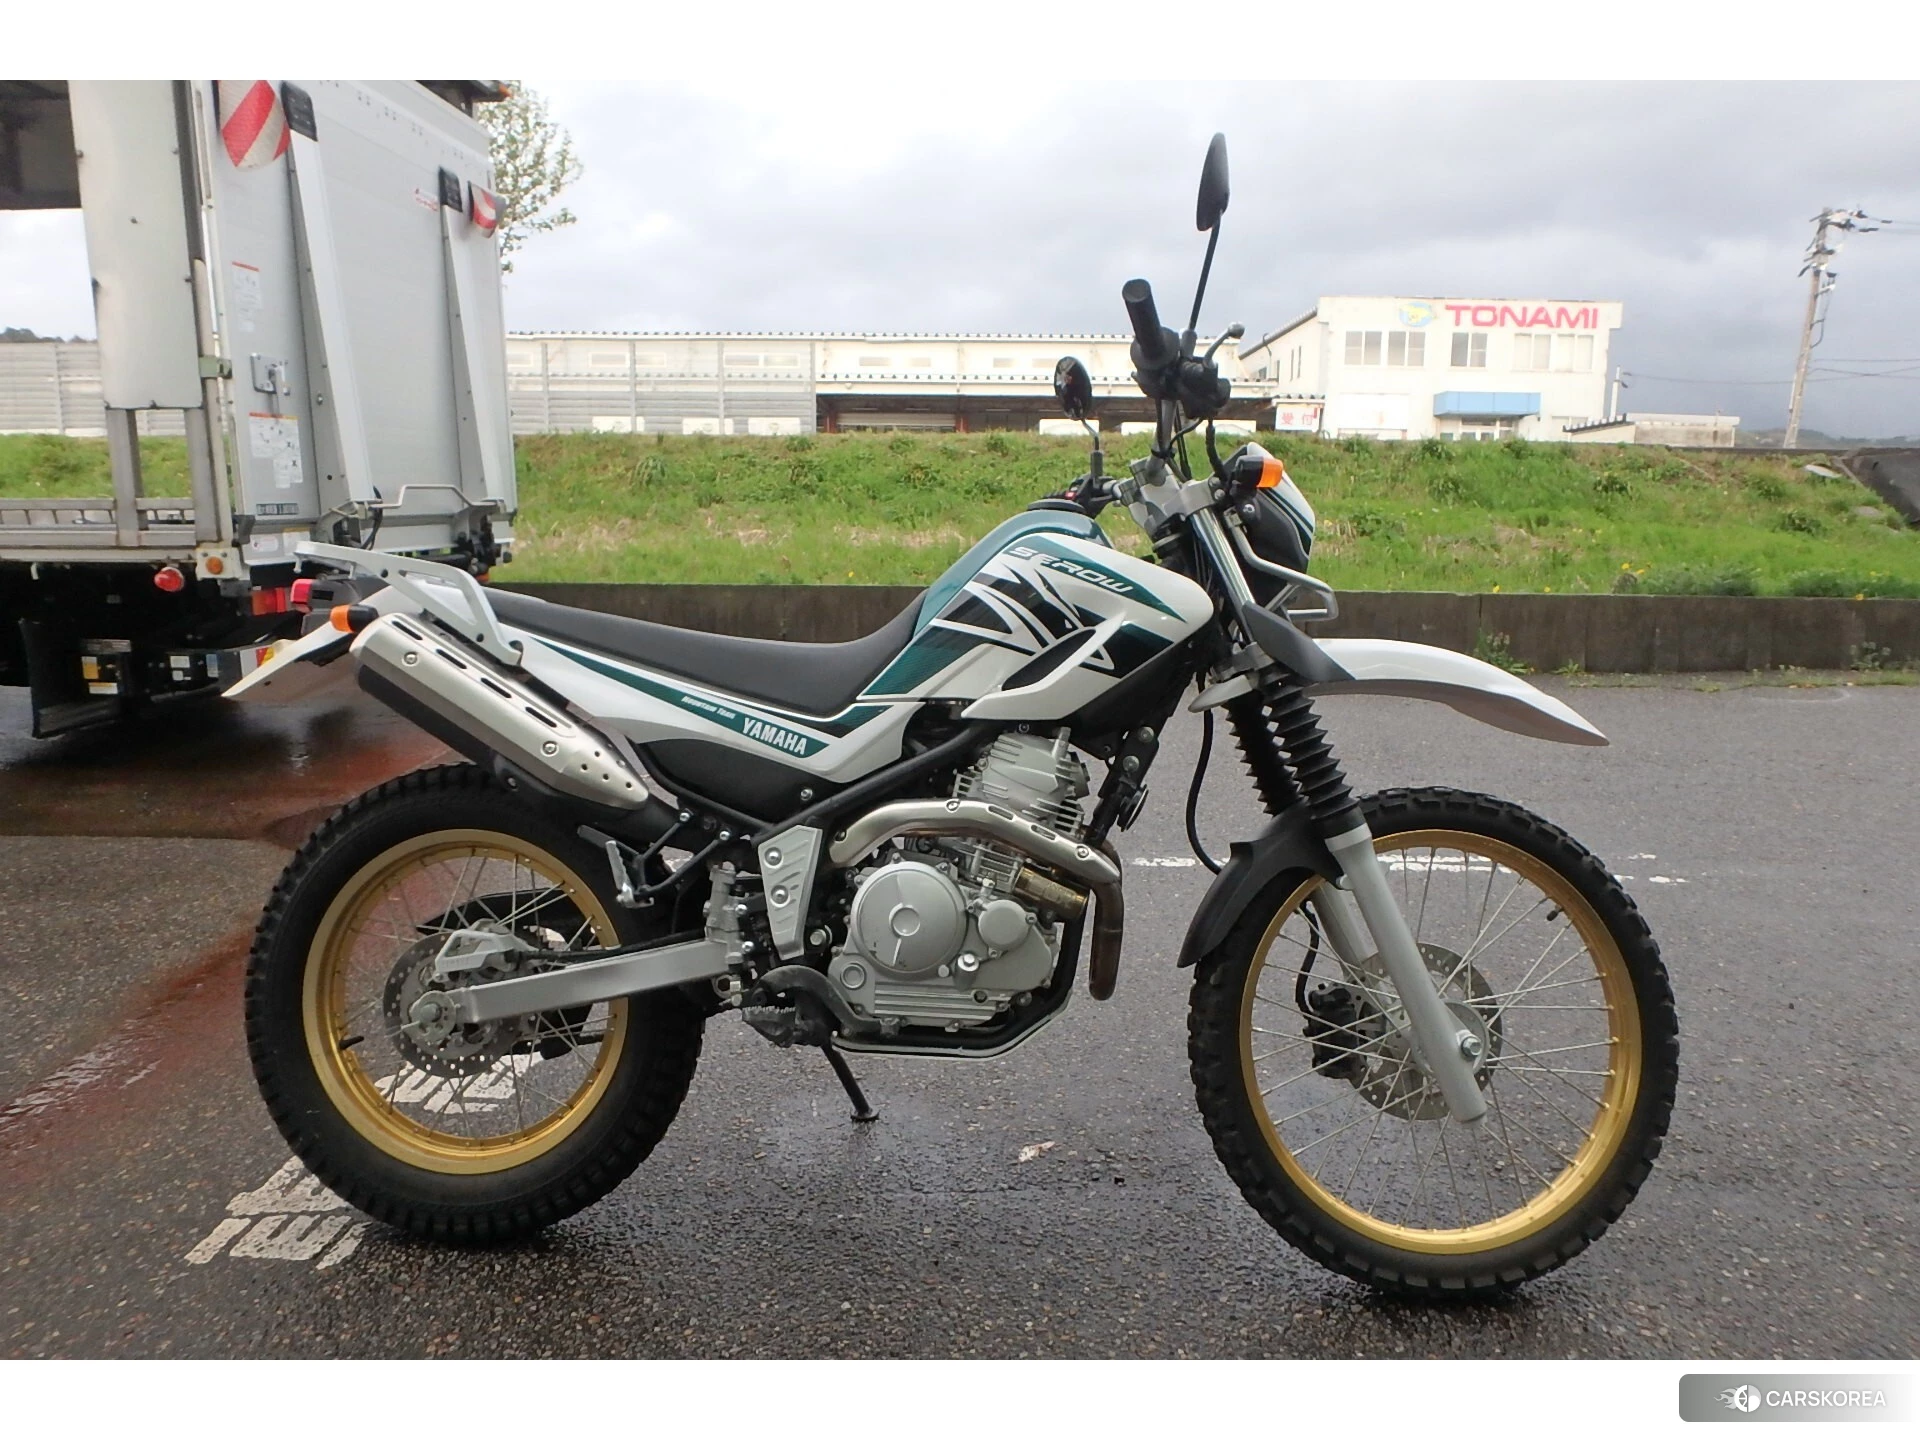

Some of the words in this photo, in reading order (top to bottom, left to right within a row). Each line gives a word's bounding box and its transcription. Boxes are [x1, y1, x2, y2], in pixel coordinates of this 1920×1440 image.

[1445, 304, 1599, 329] TONAMI
[1009, 546, 1134, 593] SEROW
[742, 717, 808, 755] YAMAHA
